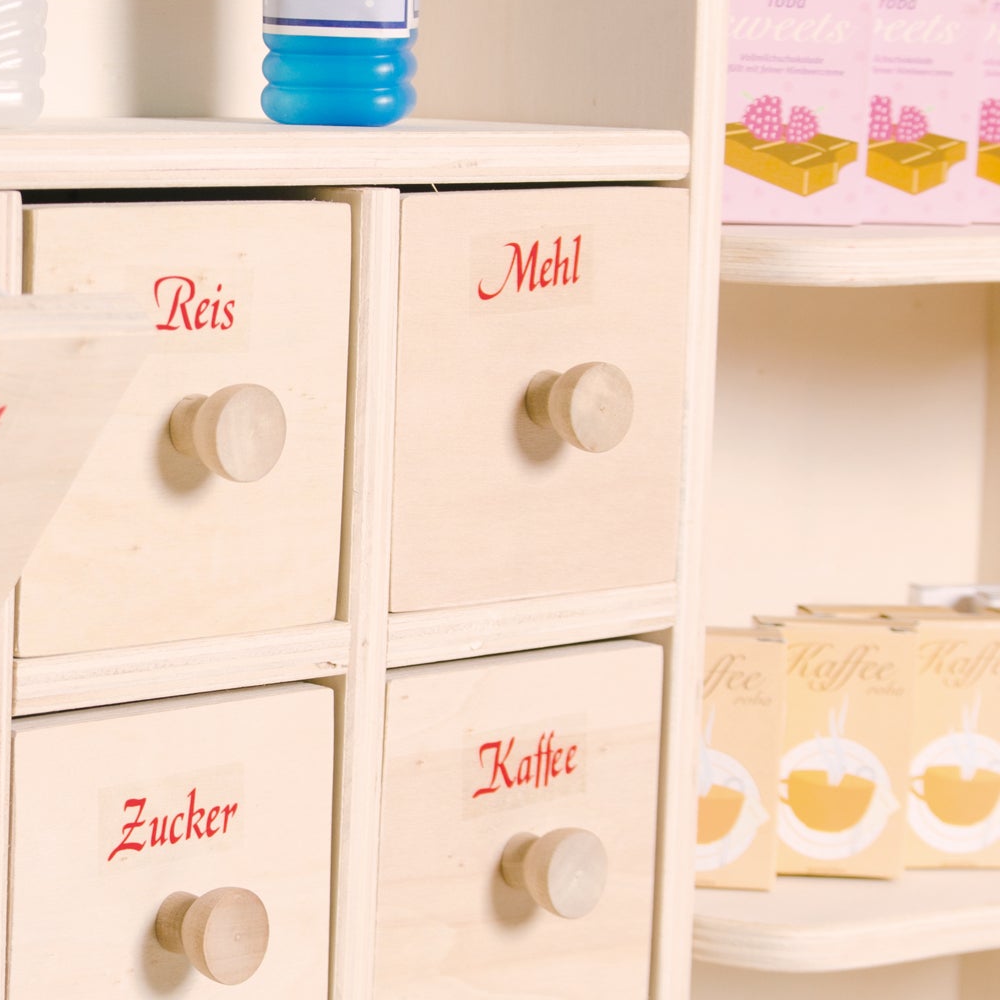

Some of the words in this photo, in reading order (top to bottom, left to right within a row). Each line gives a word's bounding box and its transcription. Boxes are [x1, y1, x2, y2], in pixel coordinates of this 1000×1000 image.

[478, 234, 582, 301] Mehl
[154, 275, 236, 331] Reis
[785, 641, 896, 692] Kaffee
[472, 730, 577, 798] Kaffee
[107, 786, 239, 862] Zucker
